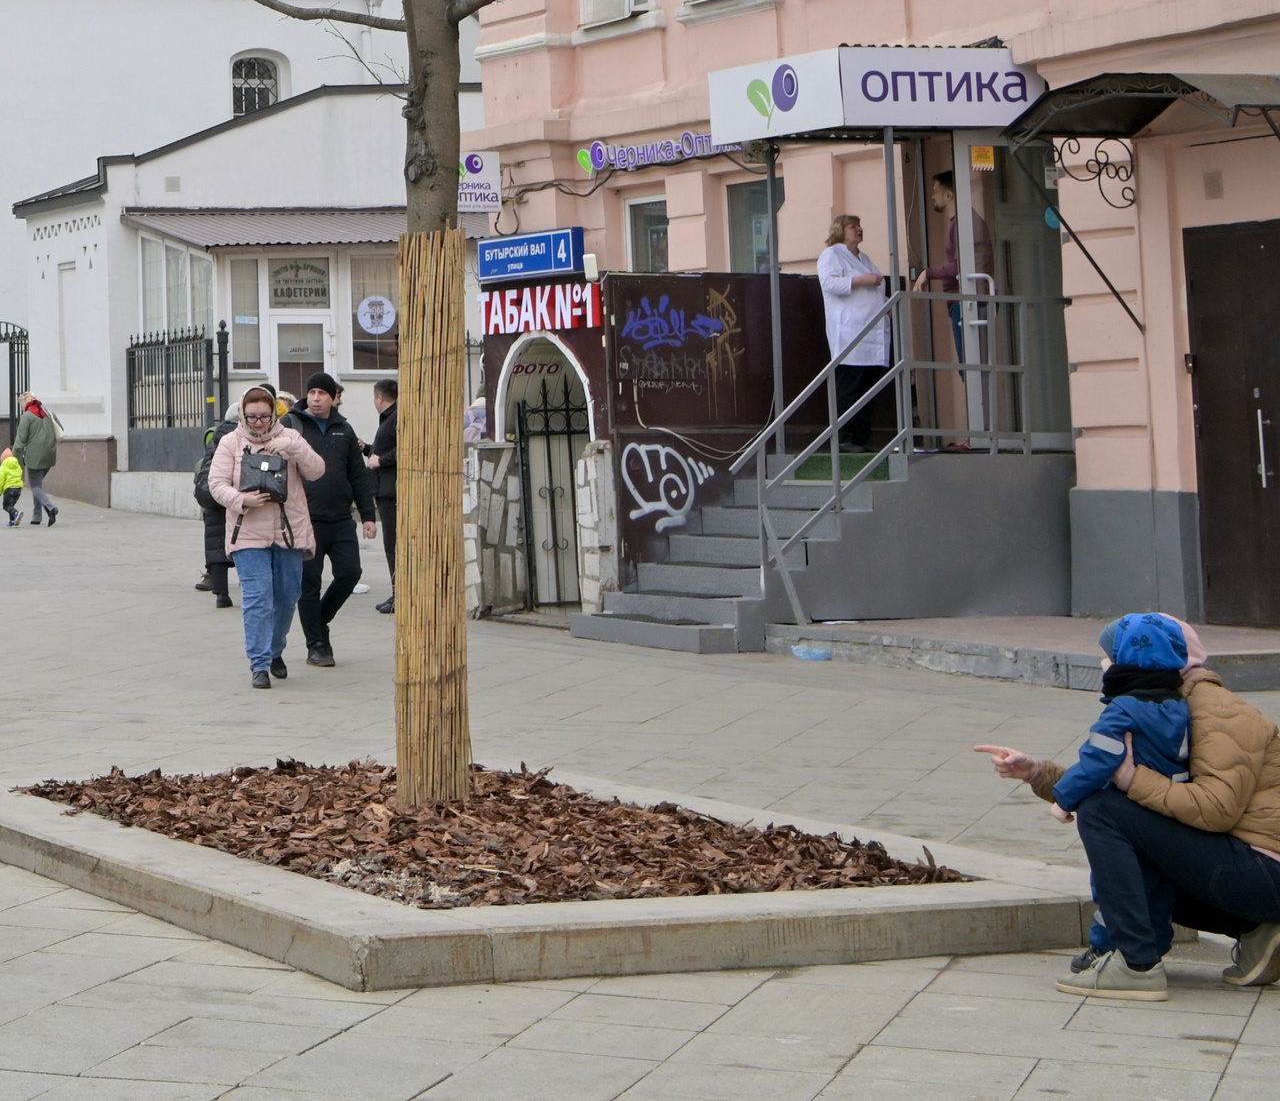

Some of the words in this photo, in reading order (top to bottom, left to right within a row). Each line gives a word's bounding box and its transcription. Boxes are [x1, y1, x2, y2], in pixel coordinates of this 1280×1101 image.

[861, 70, 1028, 103] оптика
[459, 192, 499, 203] птика
[485, 242, 529, 261] БУТЫРСКИЙ
[530, 242, 546, 255] ВАЛ
[557, 238, 567, 263] 4
[507, 262, 524, 273] улица
[274, 284, 328, 298] КАФЕТЕРИЙ
[477, 285, 552, 335] ТАБАК
[512, 362, 560, 380] ФОТО
